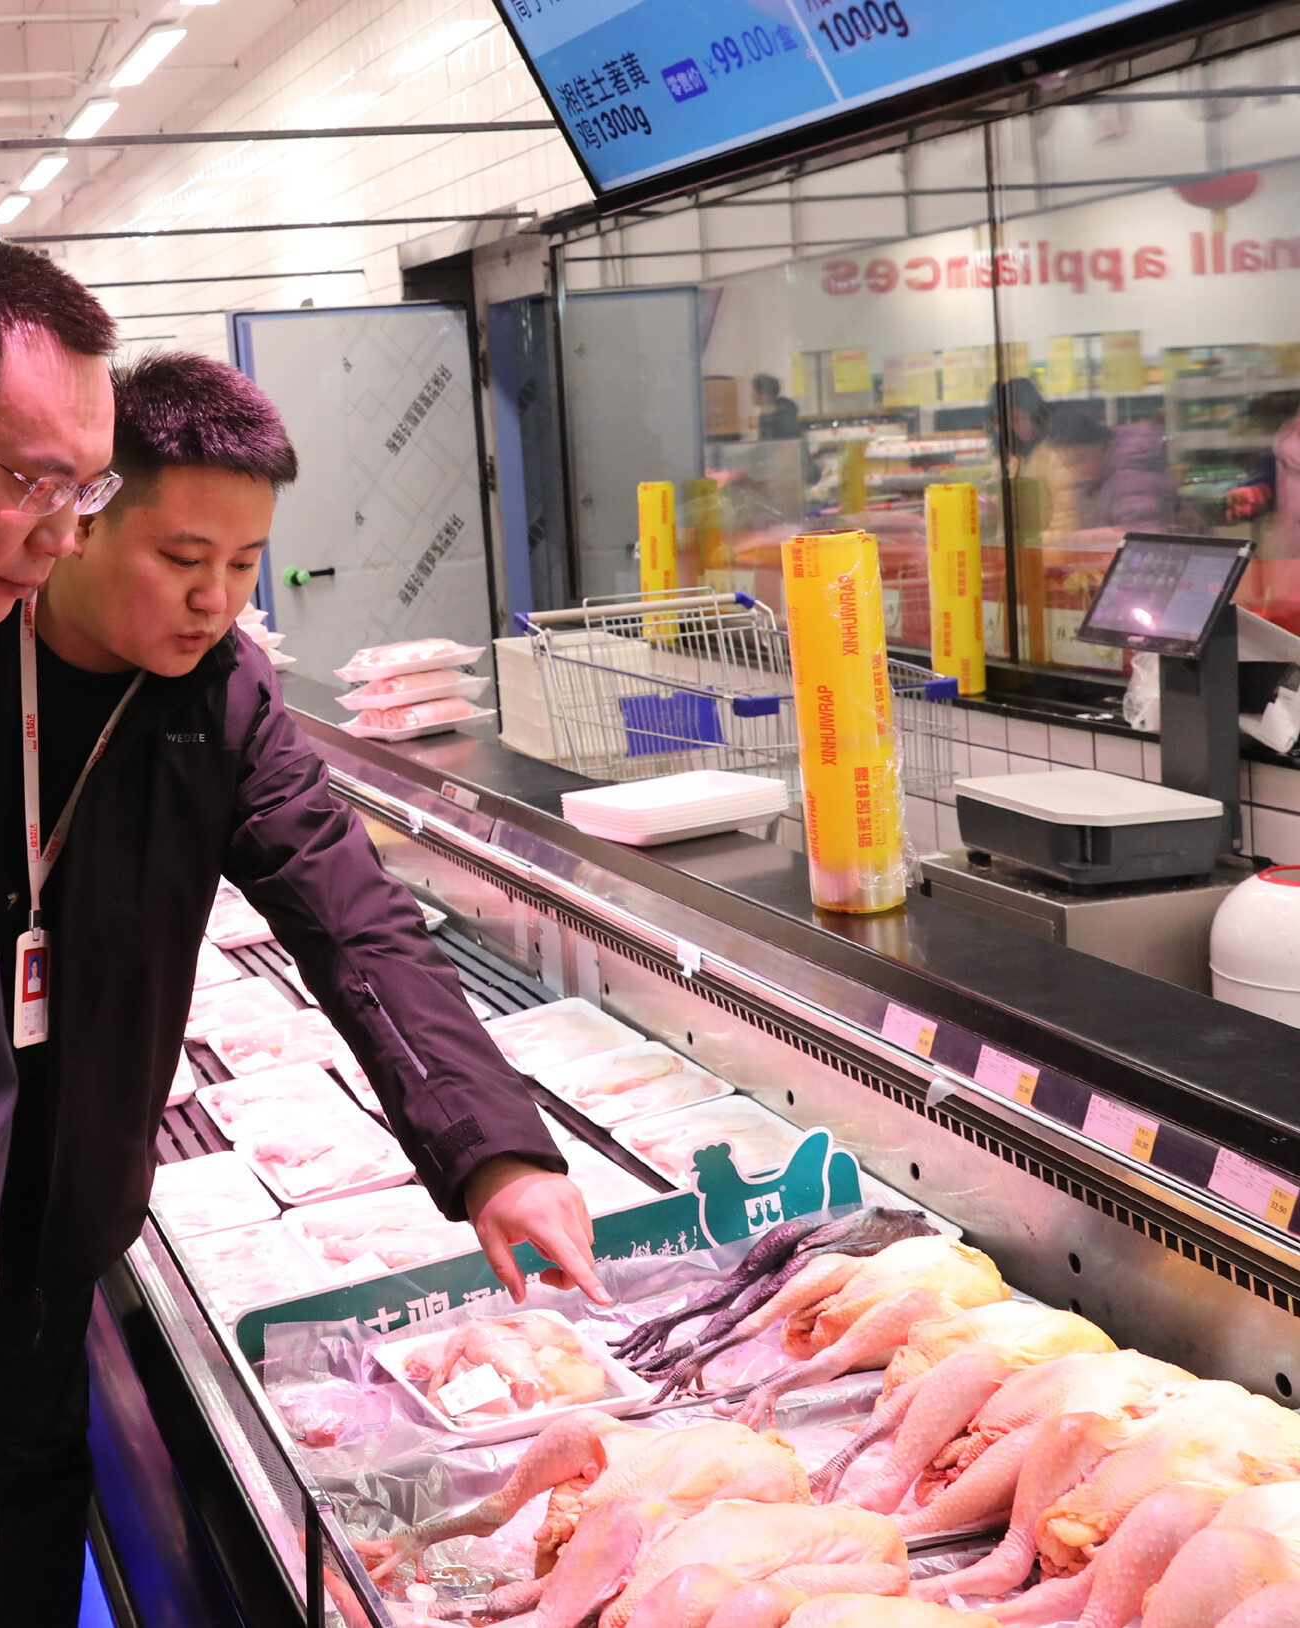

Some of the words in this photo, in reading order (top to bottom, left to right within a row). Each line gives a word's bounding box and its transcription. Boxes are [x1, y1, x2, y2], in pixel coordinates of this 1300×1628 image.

[818, 0, 909, 52] 1000g
[556, 51, 650, 117] 湘佳土著黄
[575, 104, 652, 149] 鸡1300g
[842, 574, 860, 657] XINHUIWRAP
[166, 732, 206, 743] WEDZE
[821, 685, 837, 767] XINHUIWRAP
[854, 766, 870, 848] 新辉保鲜膜
